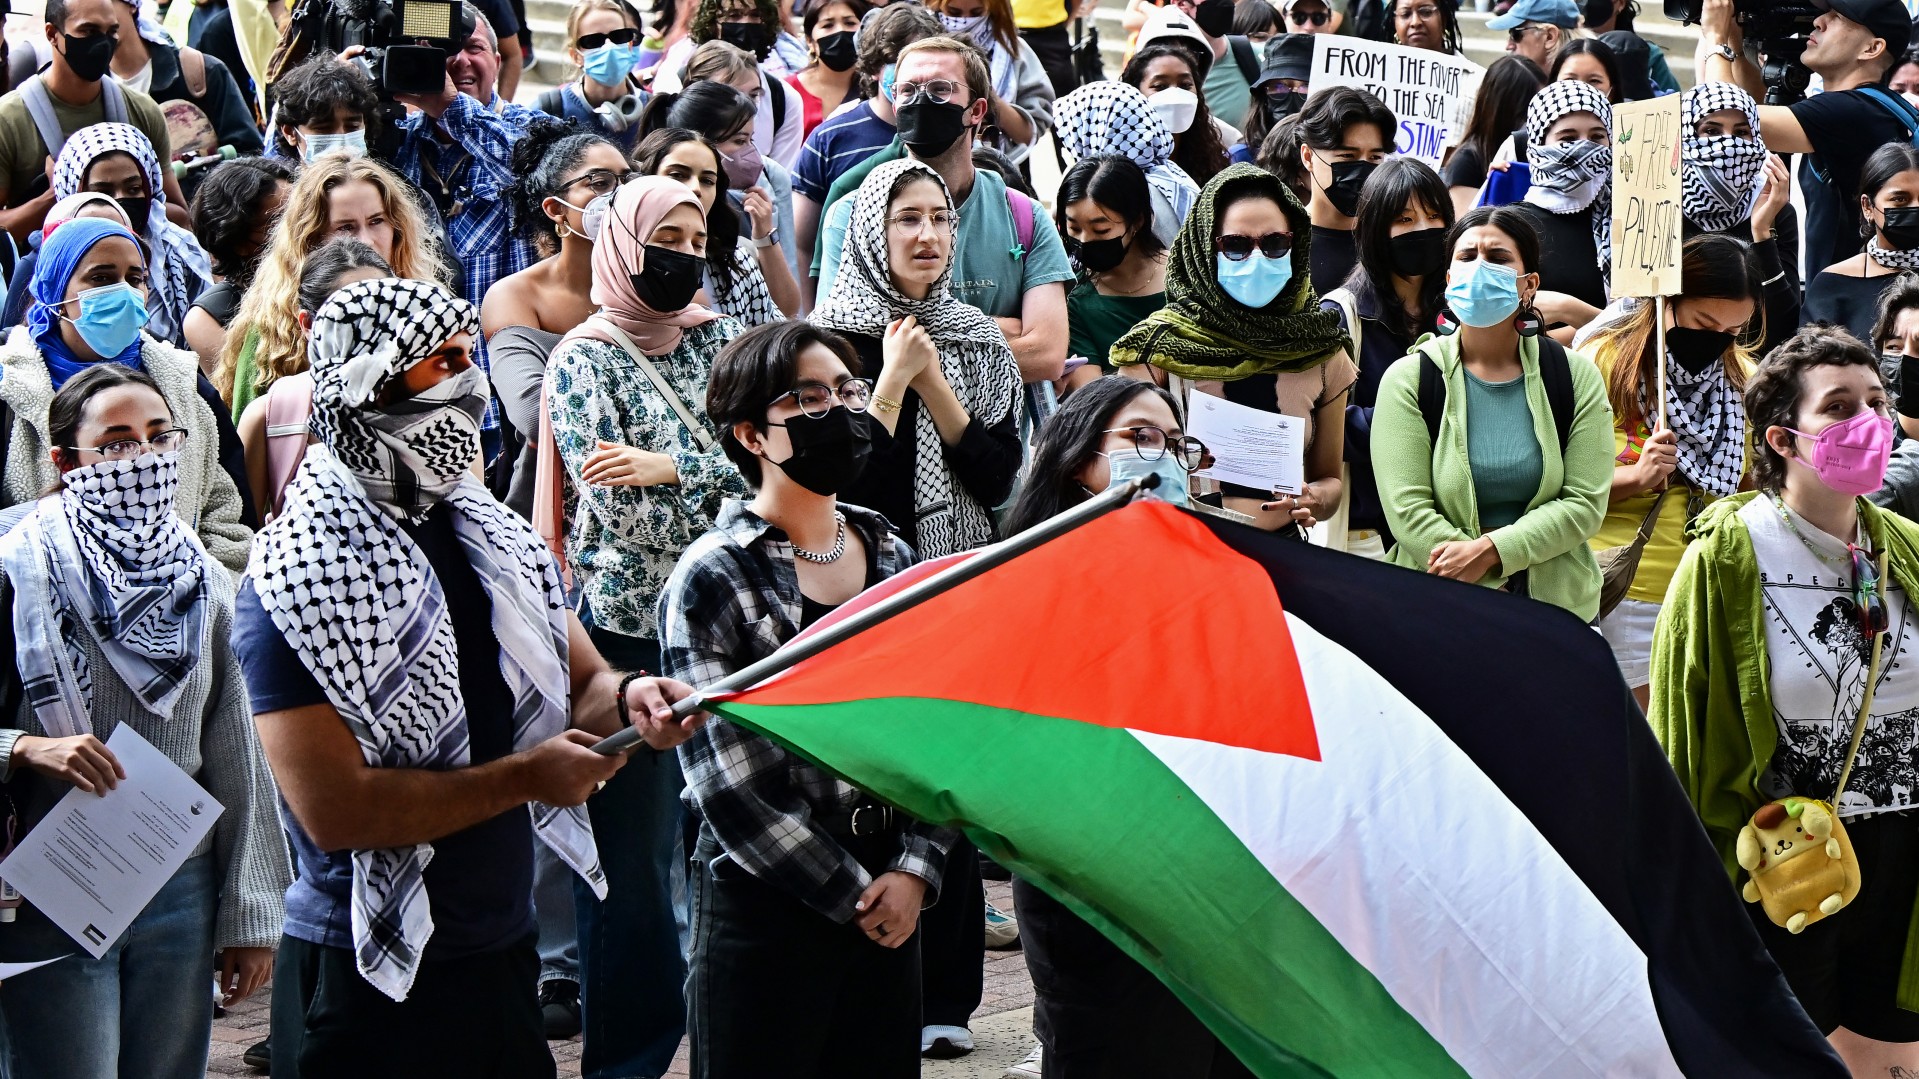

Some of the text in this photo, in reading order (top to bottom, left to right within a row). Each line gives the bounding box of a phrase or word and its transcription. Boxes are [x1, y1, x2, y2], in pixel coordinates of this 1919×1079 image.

[1325, 47, 1460, 98] FROM THE RIVER
[1393, 89, 1420, 117] THE
[1396, 120, 1448, 159] STINE
[1636, 110, 1672, 190] FREE
[1619, 196, 1680, 275] PALESTINE
[948, 280, 995, 288] OUNTAIN
[1760, 572, 1845, 587] SPEC
